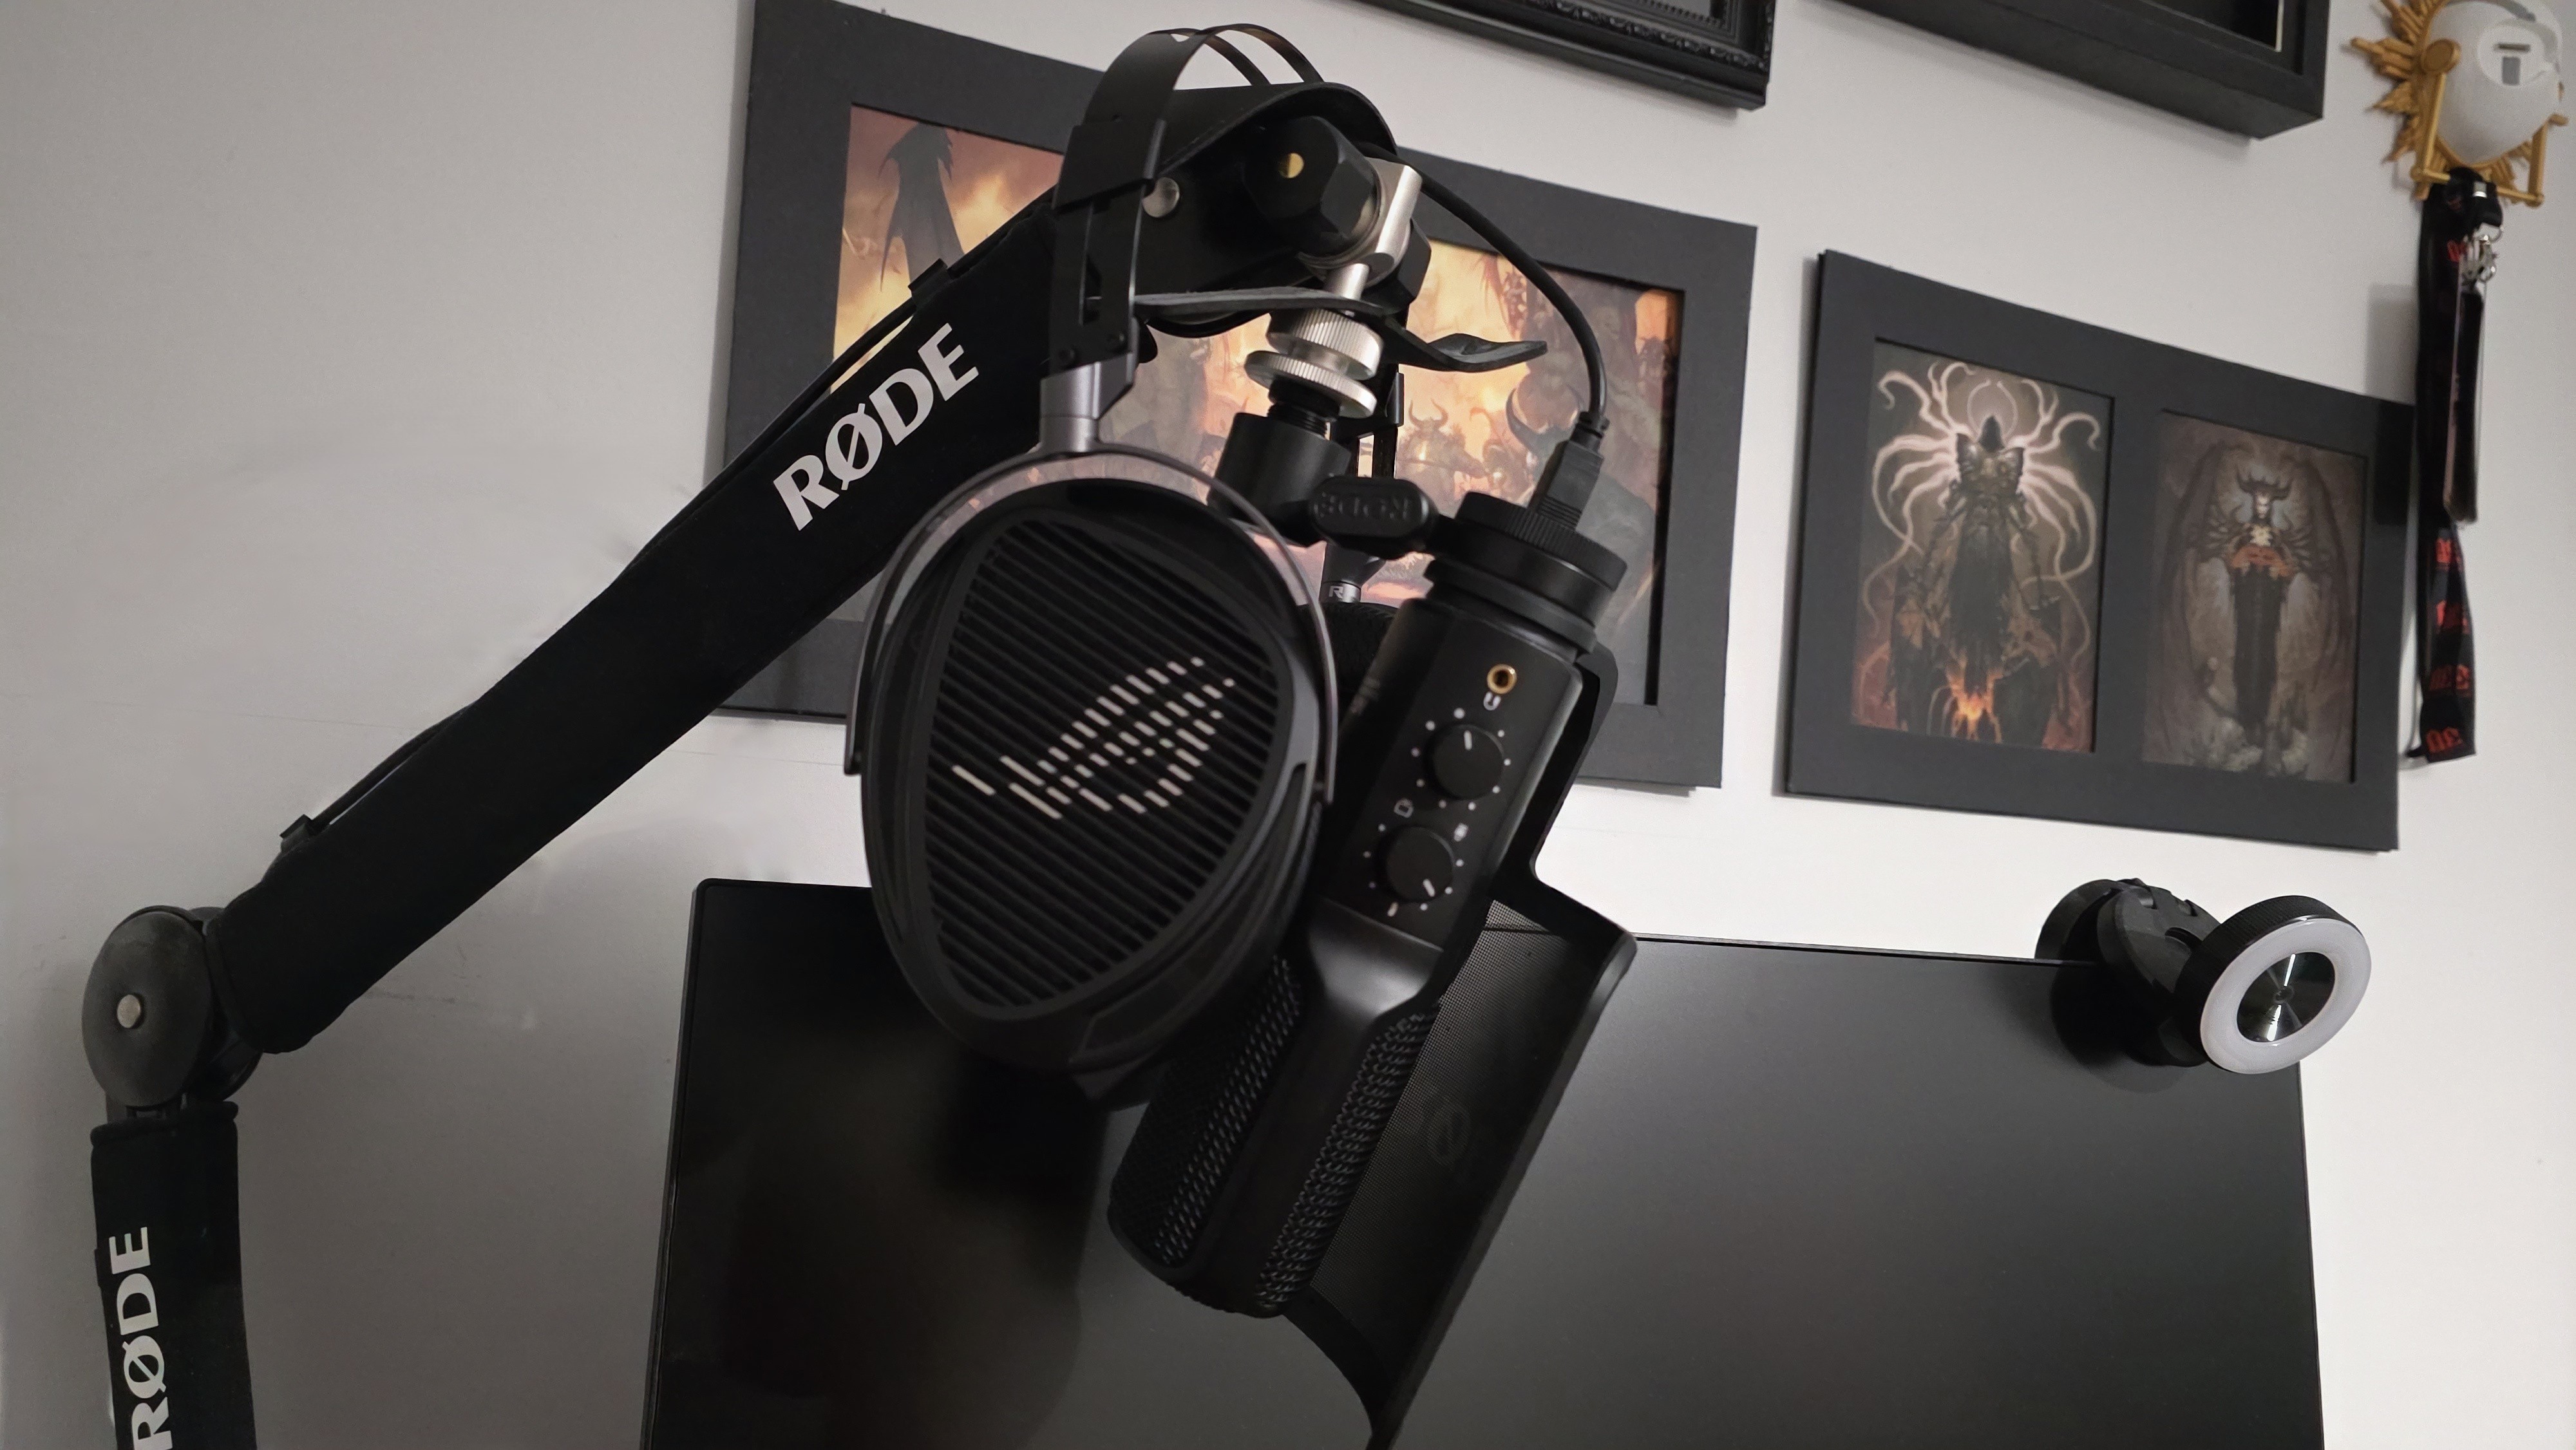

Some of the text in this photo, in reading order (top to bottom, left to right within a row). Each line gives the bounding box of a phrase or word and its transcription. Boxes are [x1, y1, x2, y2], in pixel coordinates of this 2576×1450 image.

[773, 323, 979, 532] RØDE
[1329, 585, 1344, 599] R
[109, 1227, 173, 1450] RØDE
